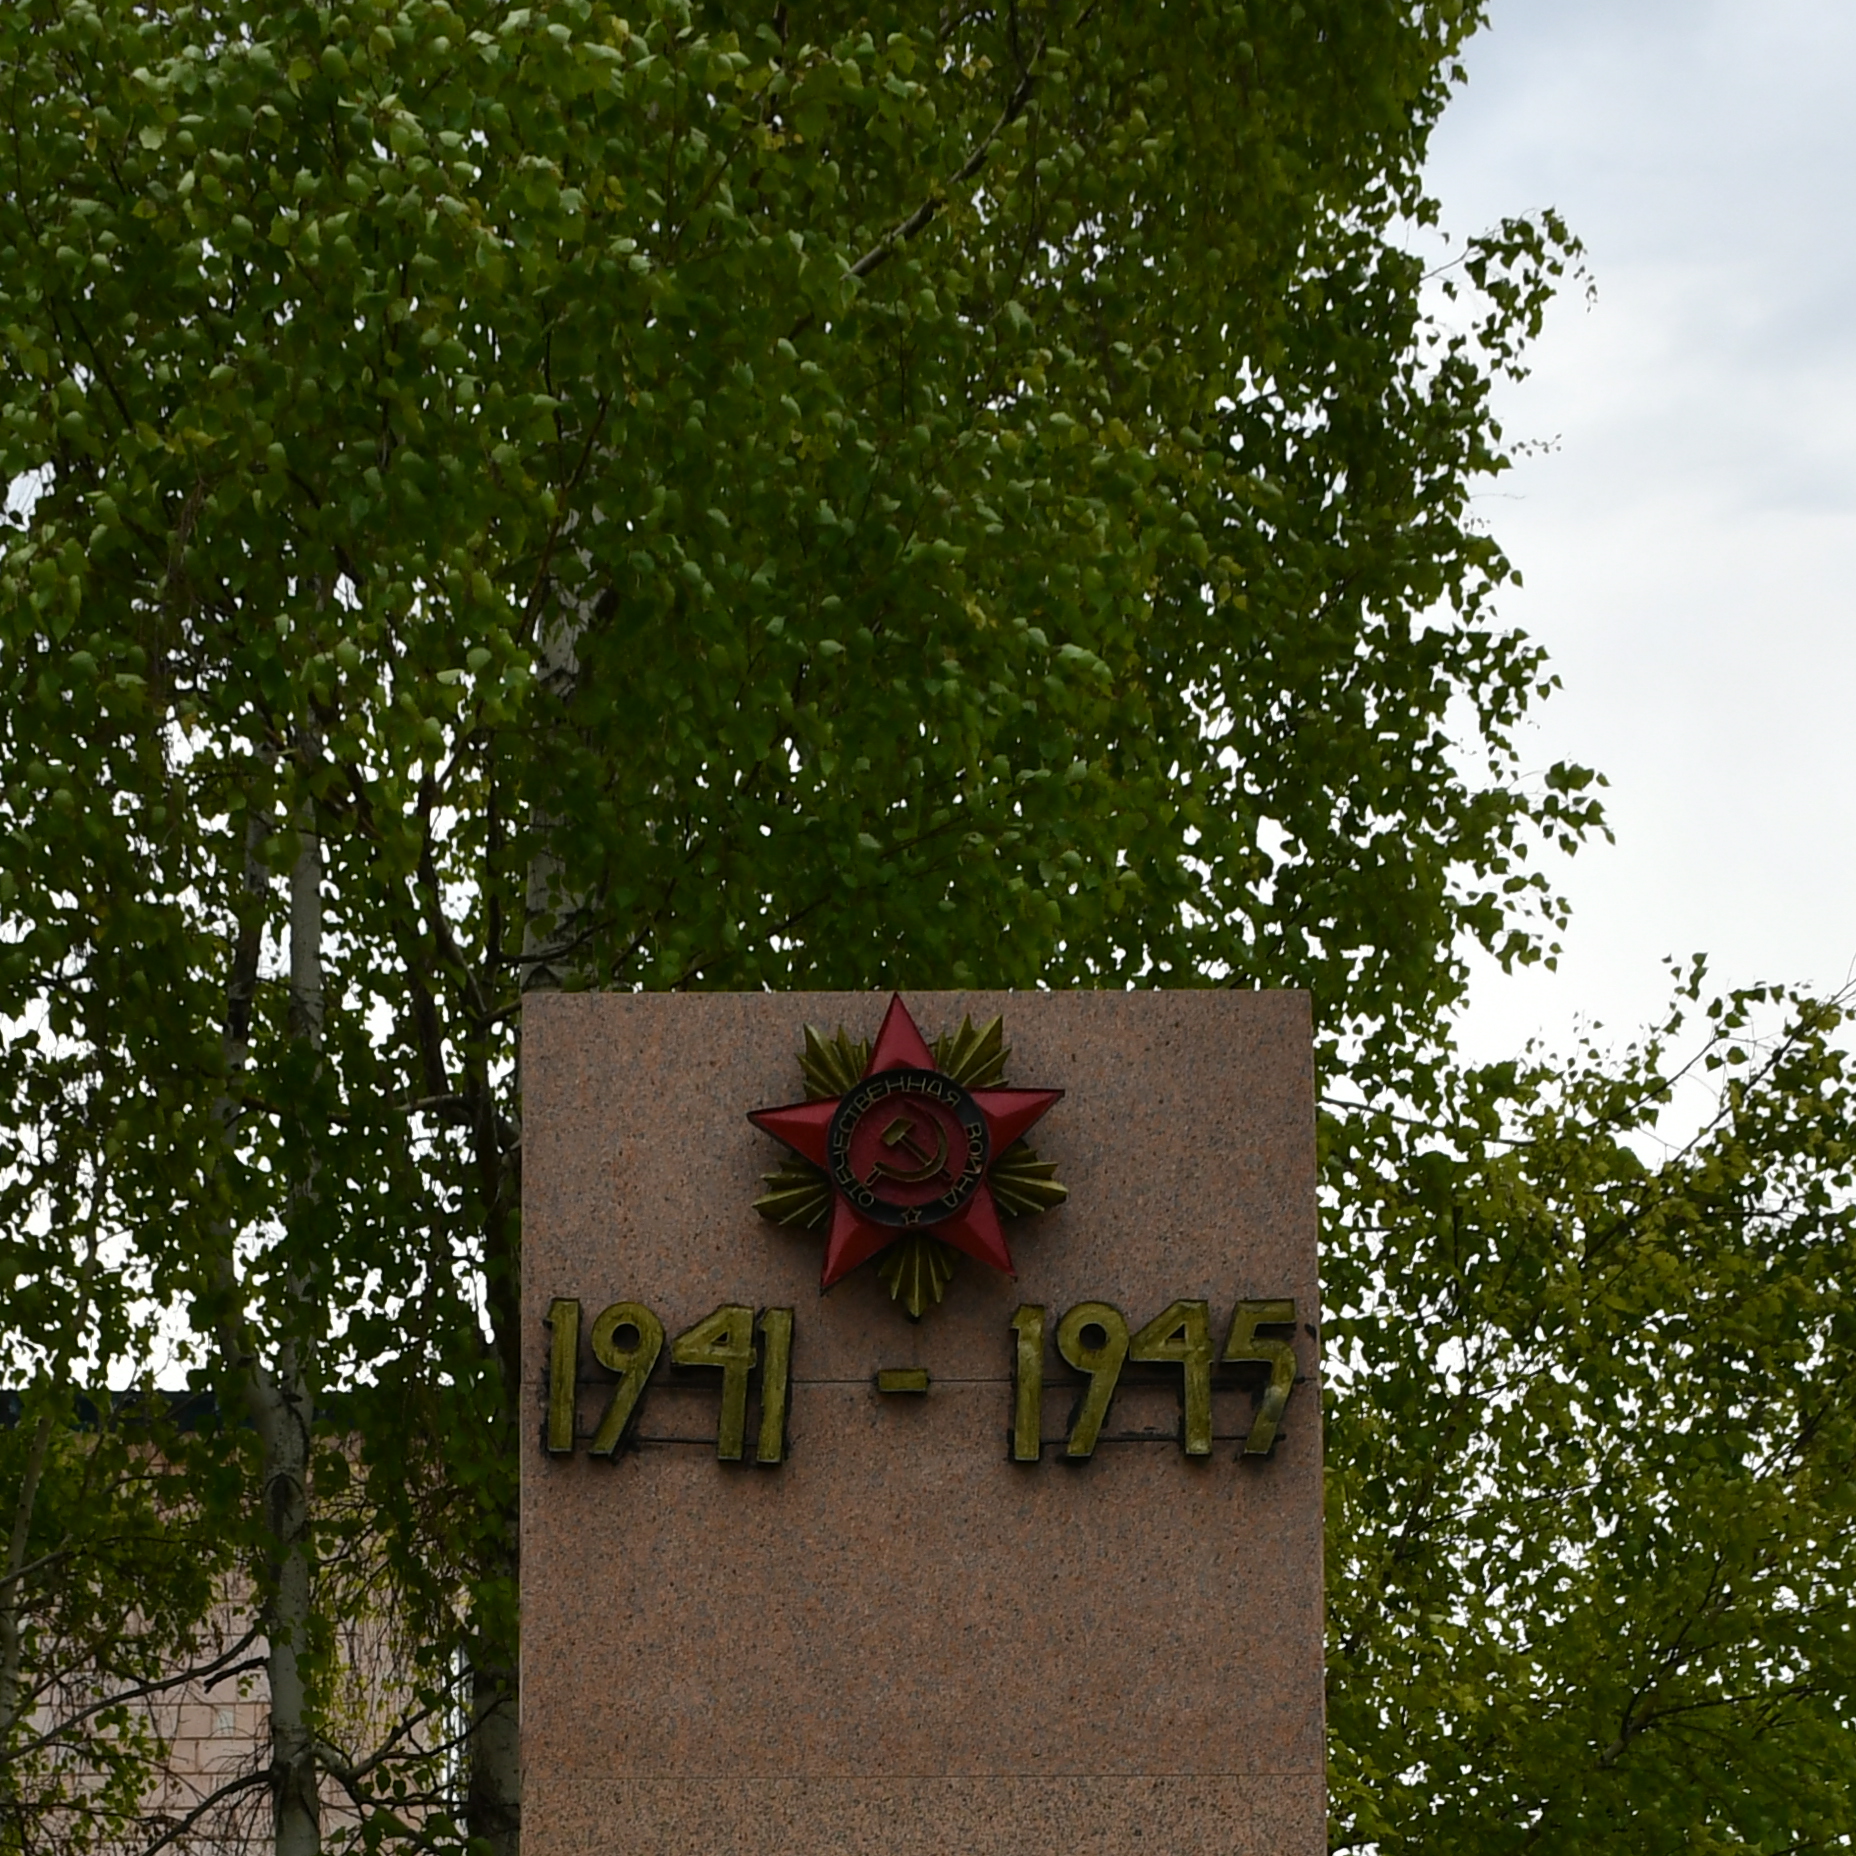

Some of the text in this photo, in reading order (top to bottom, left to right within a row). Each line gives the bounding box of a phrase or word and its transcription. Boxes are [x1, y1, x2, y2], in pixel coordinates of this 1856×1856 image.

[833, 1075, 961, 1207] ОТЕЧЕСТВЕННАЯ
[546, 1297, 794, 1463] 1941
[1011, 1298, 1297, 1462] 1945
